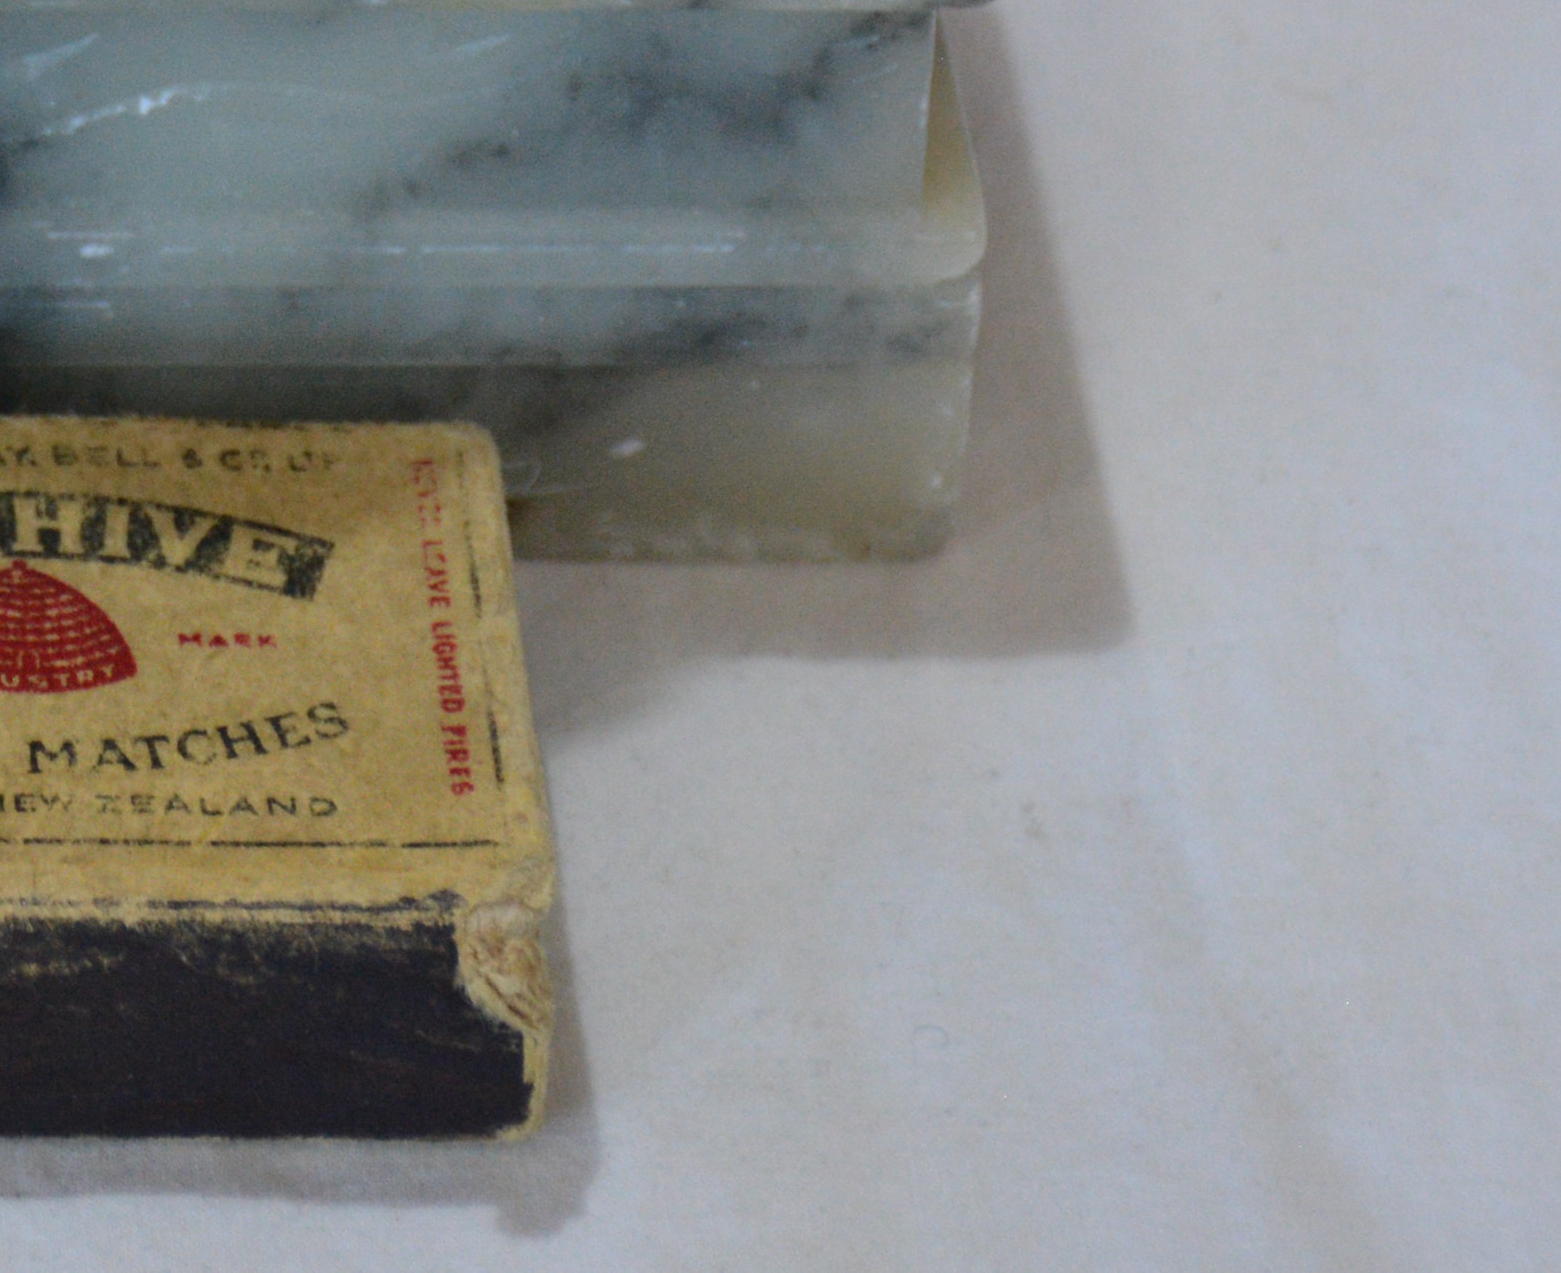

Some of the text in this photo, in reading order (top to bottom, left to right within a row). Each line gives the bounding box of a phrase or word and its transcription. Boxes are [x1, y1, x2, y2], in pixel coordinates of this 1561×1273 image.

[181, 446, 204, 470] &
[178, 632, 278, 649] MARK
[431, 619, 467, 715] LIGHTED
[27, 701, 352, 775] MATCHES
[441, 723, 476, 798] FIRES
[94, 792, 340, 819] ZEALAND
